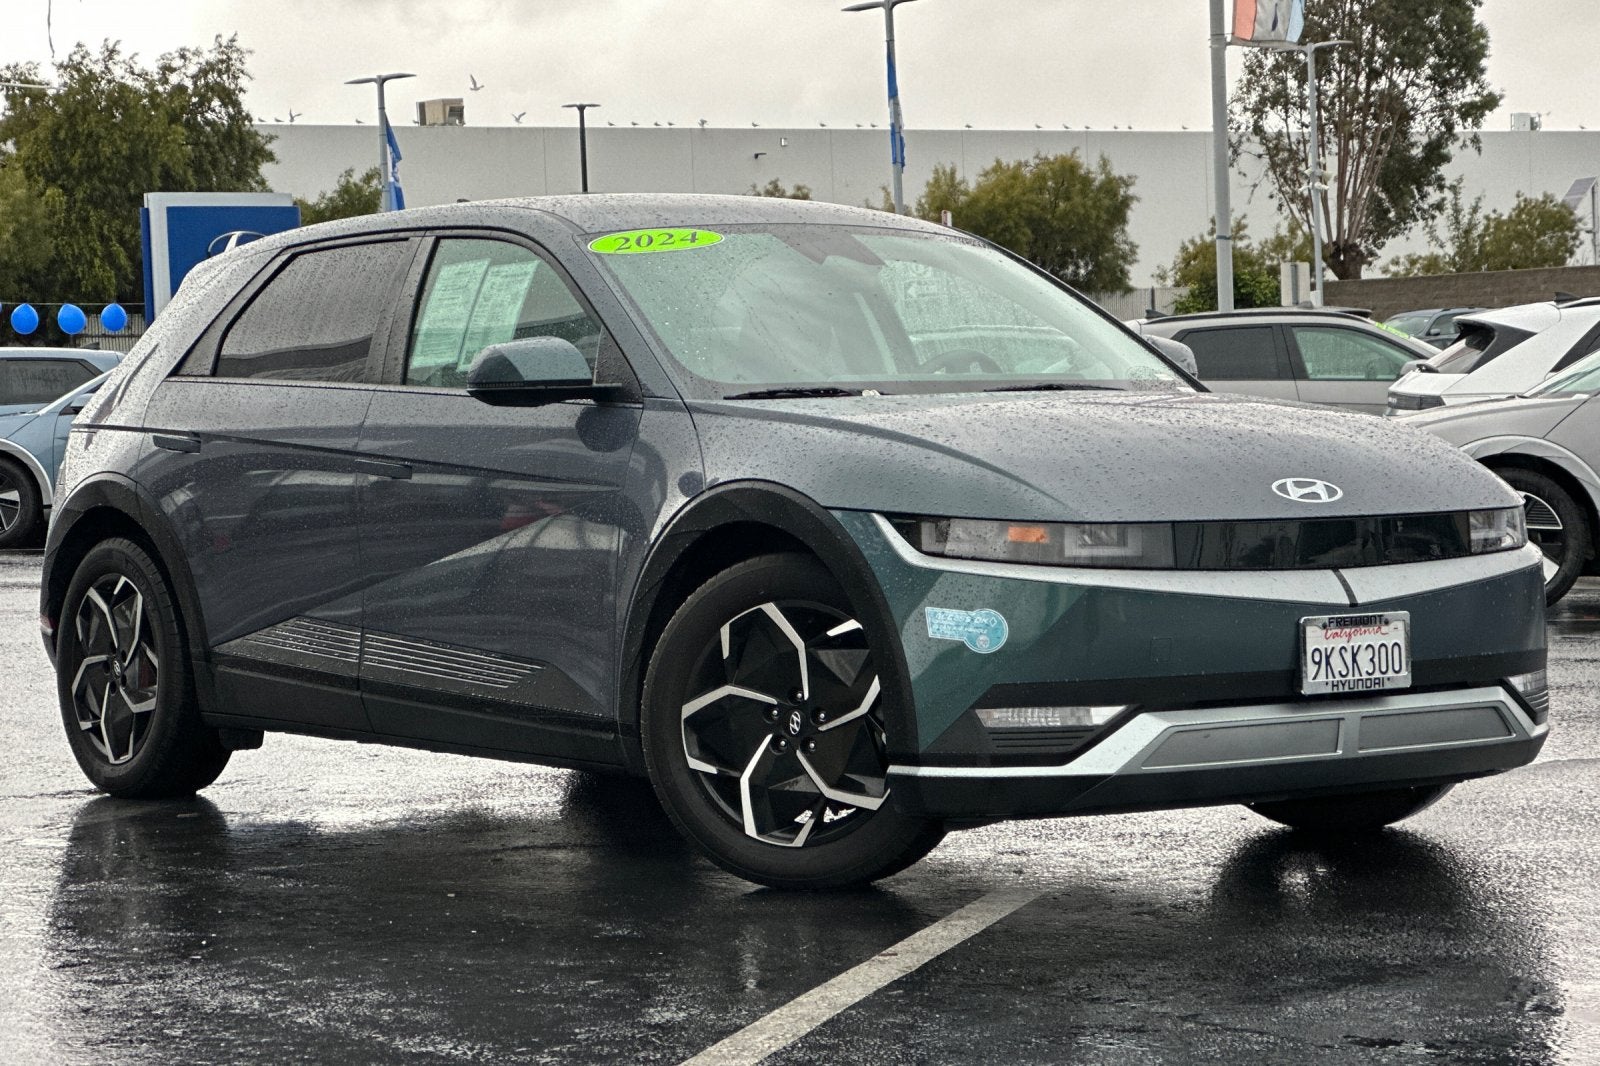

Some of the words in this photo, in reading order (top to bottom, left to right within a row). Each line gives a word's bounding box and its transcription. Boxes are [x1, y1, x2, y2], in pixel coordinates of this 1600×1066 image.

[614, 231, 699, 253] 2024
[1328, 615, 1384, 627] FREMONT
[1324, 626, 1389, 641] California
[1311, 642, 1402, 680] 9KSK300
[1332, 677, 1384, 691] HYUNDAI
